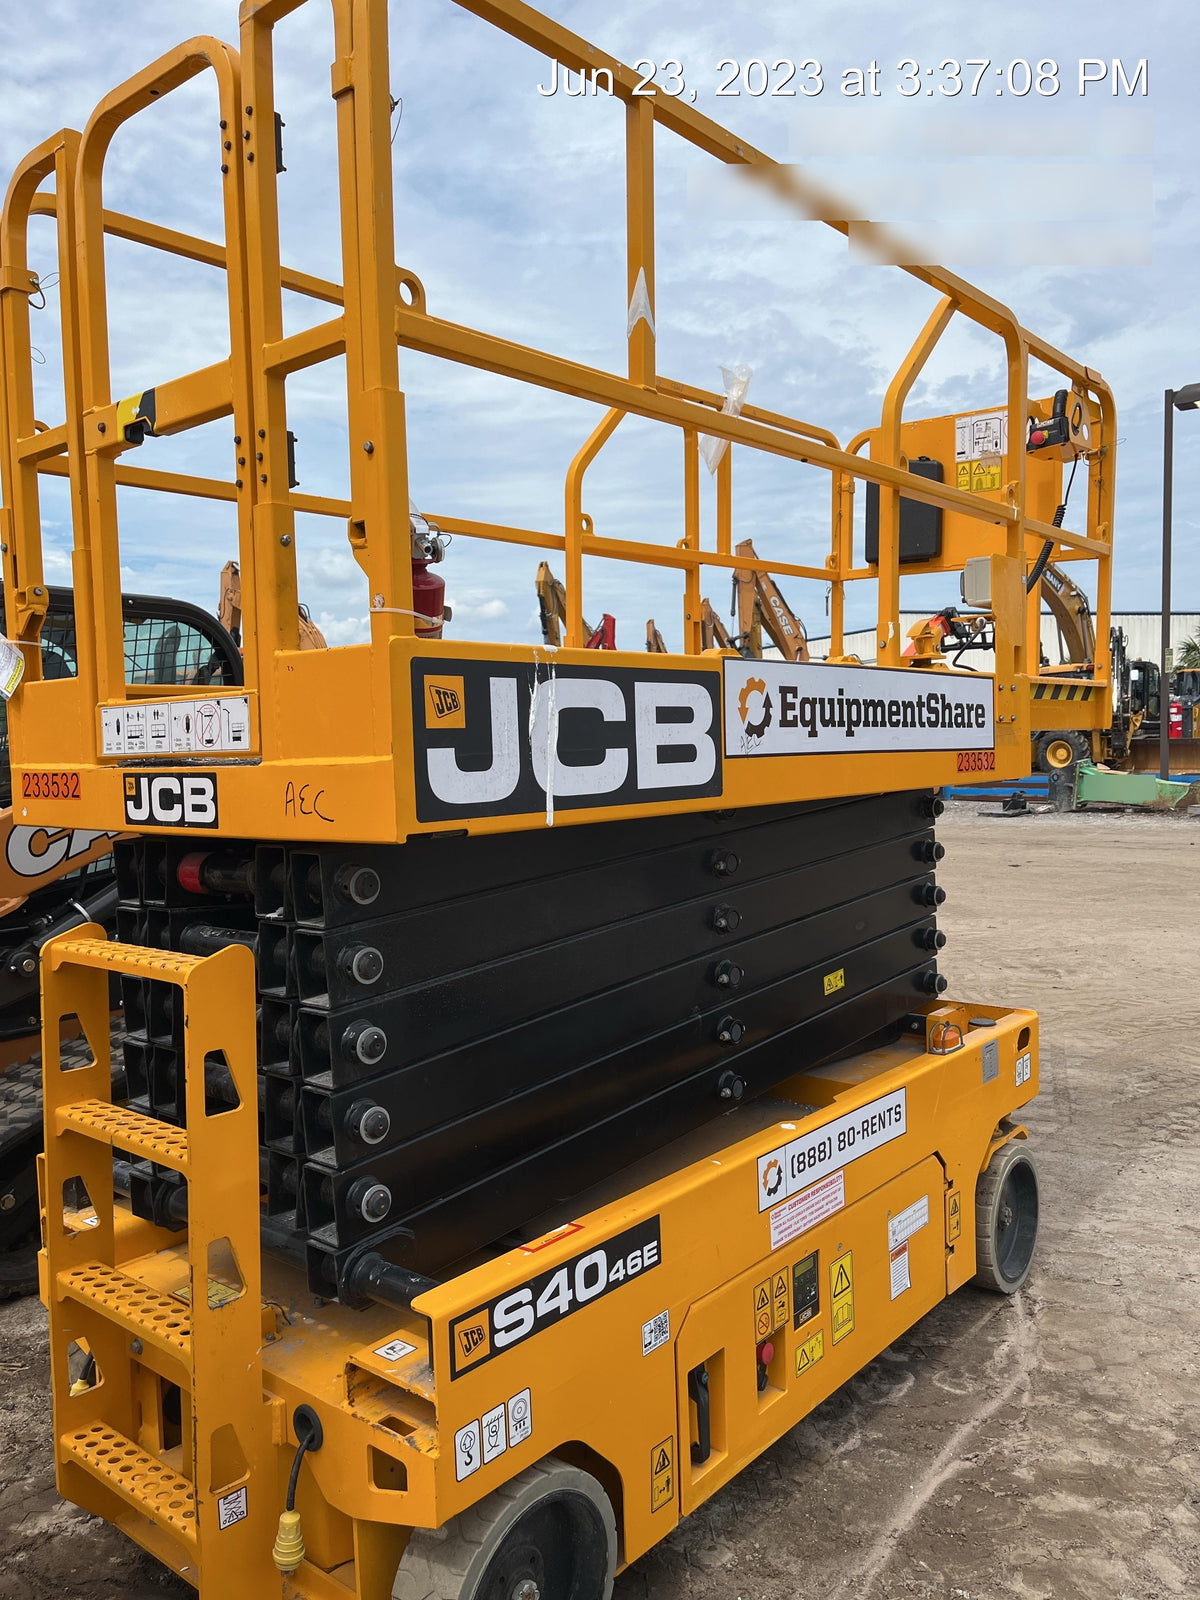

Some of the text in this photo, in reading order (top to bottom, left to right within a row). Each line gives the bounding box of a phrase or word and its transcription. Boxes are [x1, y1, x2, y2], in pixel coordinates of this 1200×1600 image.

[770, 596, 793, 635] CASE
[434, 688, 459, 714] JCB
[779, 686, 986, 738] EquipmentShare
[427, 677, 716, 804] JCB
[957, 751, 995, 771] 233532
[22, 772, 80, 799] 233532
[127, 777, 216, 823] JCB
[791, 1103, 902, 1179] (888) 80-RENTS
[463, 1325, 485, 1353] JCB
